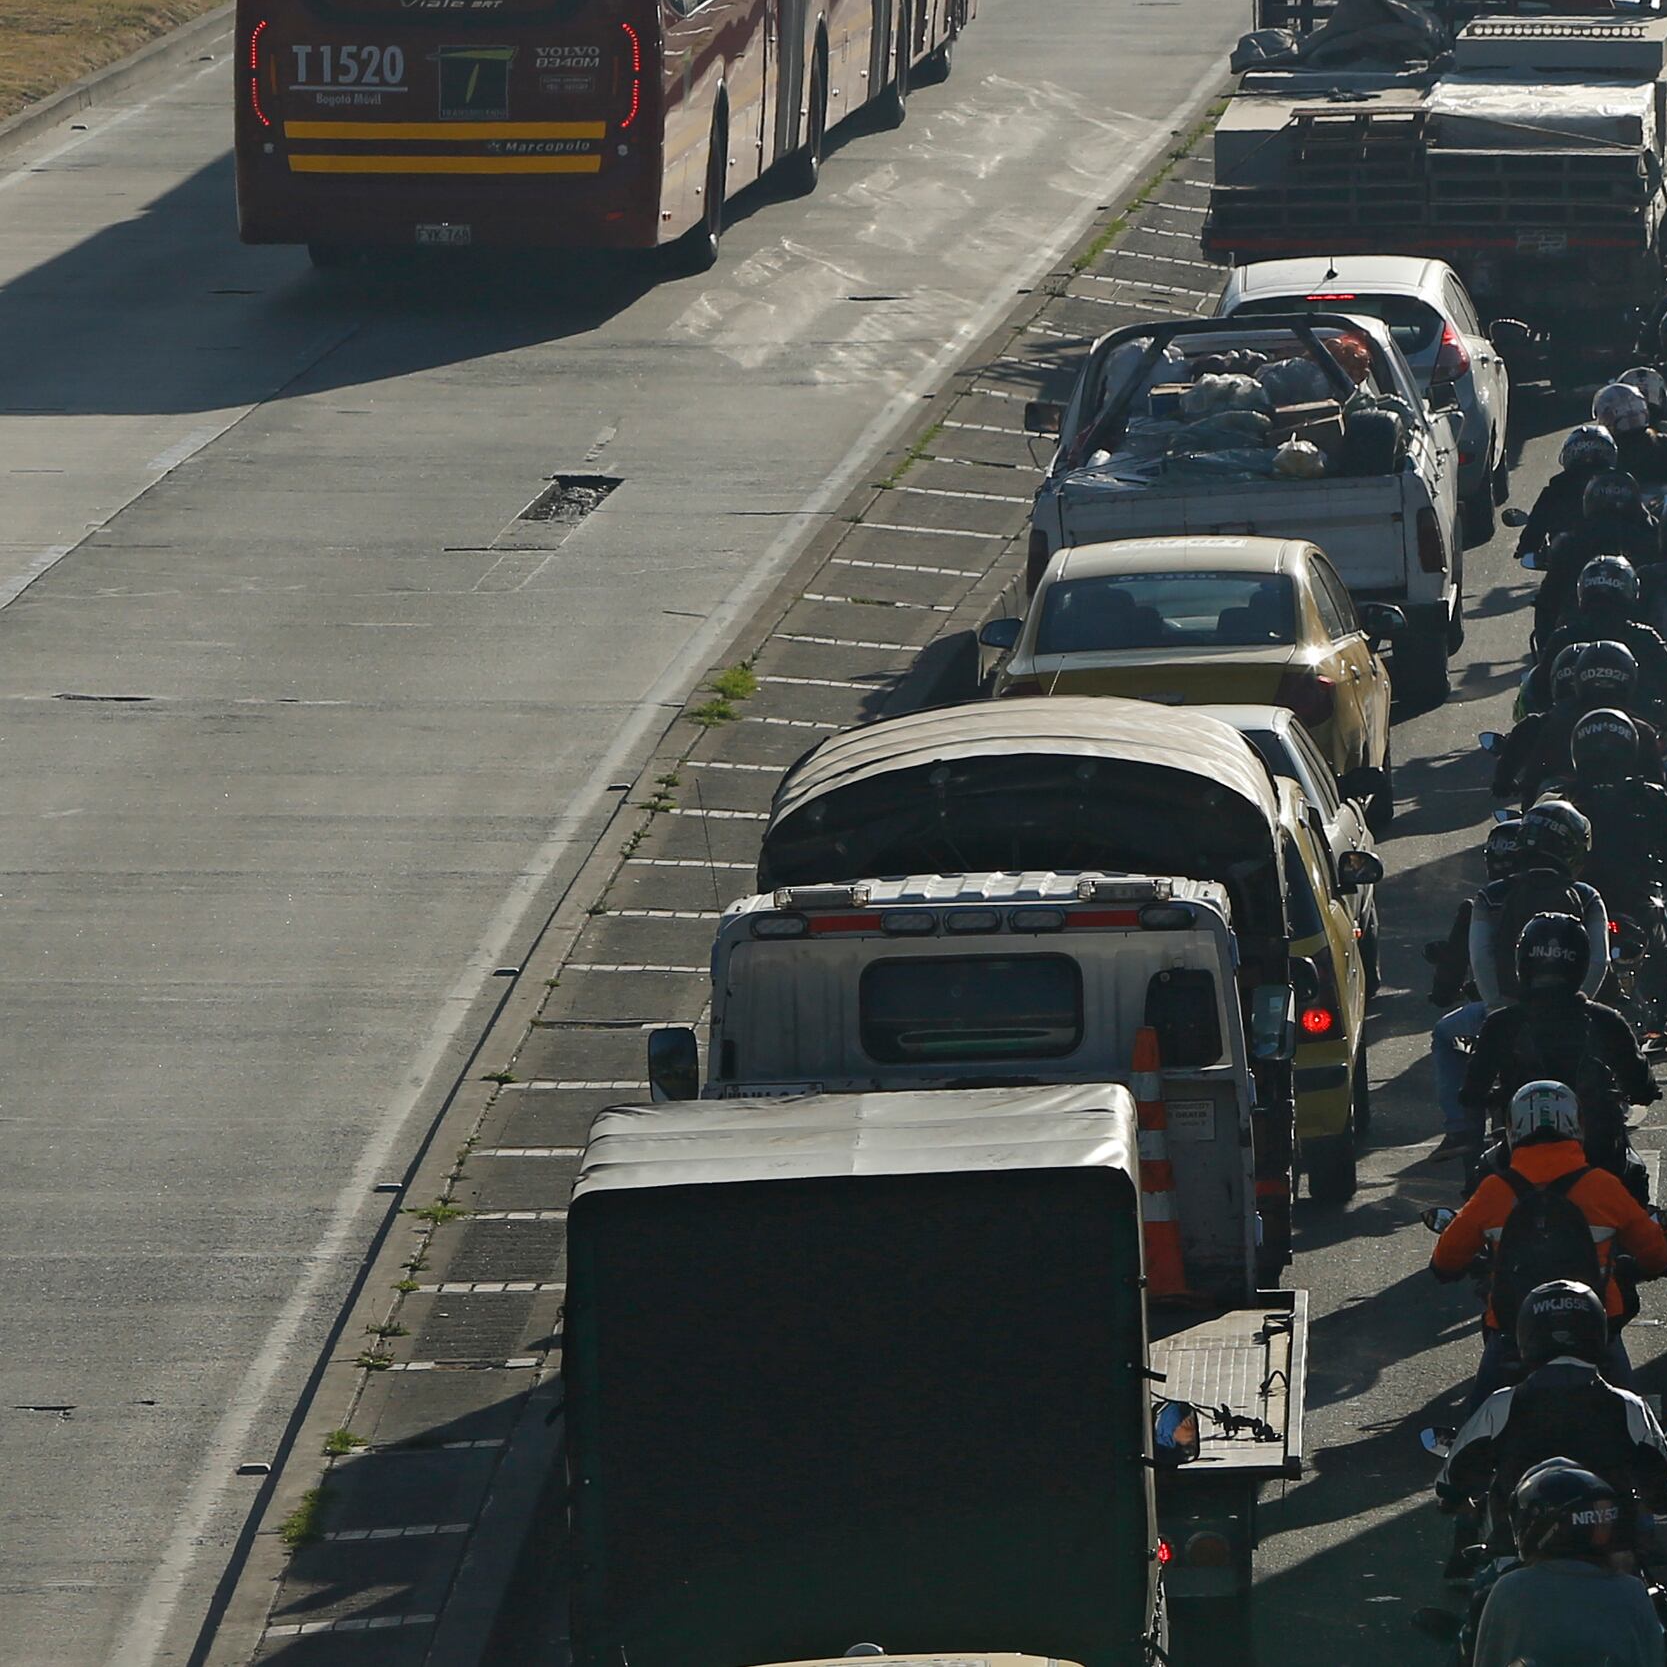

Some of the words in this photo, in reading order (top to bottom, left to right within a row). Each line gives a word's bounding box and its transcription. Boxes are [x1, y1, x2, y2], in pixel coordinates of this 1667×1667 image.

[536, 45, 600, 57] VOLVO
[505, 140, 591, 153] Marcopolo
[1528, 945, 1577, 962] JNJ61C
